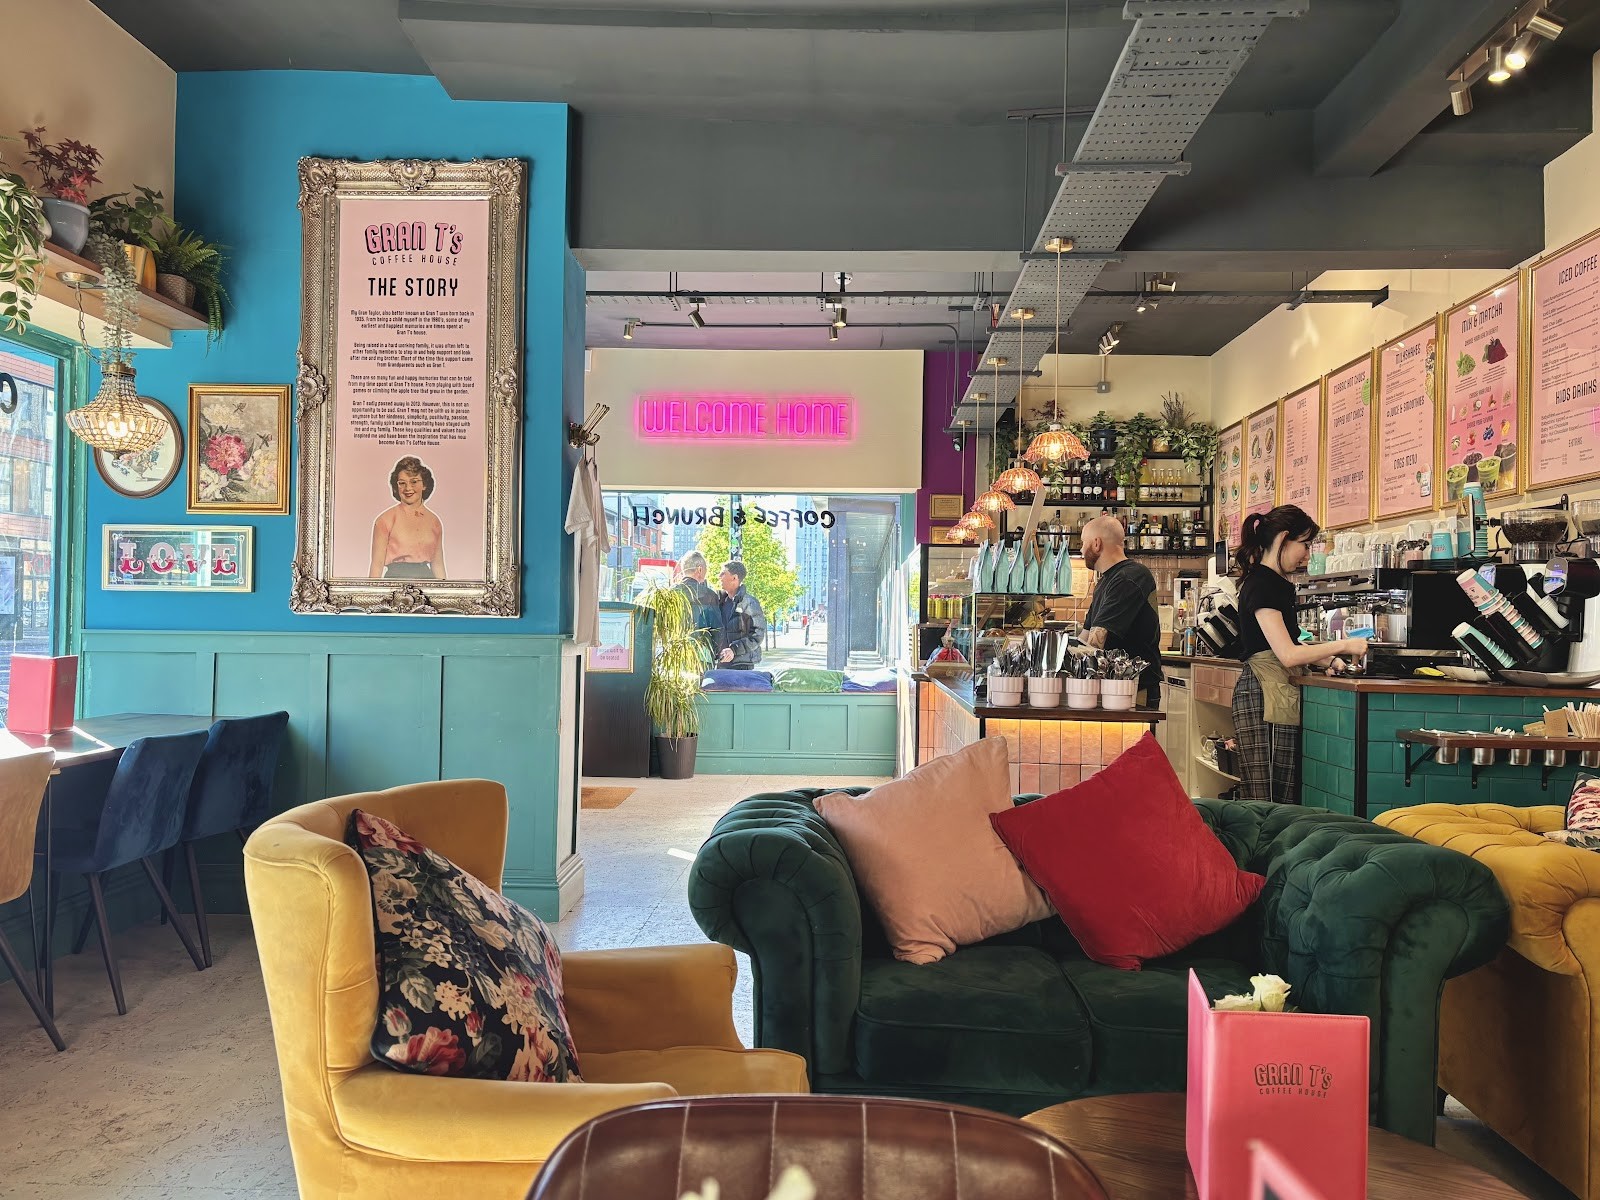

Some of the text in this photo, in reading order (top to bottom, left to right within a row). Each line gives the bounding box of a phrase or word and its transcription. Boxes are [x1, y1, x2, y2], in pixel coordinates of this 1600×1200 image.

[365, 221, 463, 254] GRAN T's
[372, 254, 457, 266] COFFEE HOUSE
[1559, 254, 1597, 285] ICED COFFEE
[368, 278, 458, 296] THE STORY
[1461, 317, 1473, 333] MIX
[1479, 302, 1503, 325] MATCHA
[1556, 387, 1570, 404] KIDS
[1572, 379, 1597, 399] DRINKS
[643, 400, 848, 436] WELCOME HOME
[119, 542, 237, 575] LOVE
[1254, 1063, 1332, 1090] GRAN T's
[1259, 1087, 1327, 1098] COFFEE HOUSE
